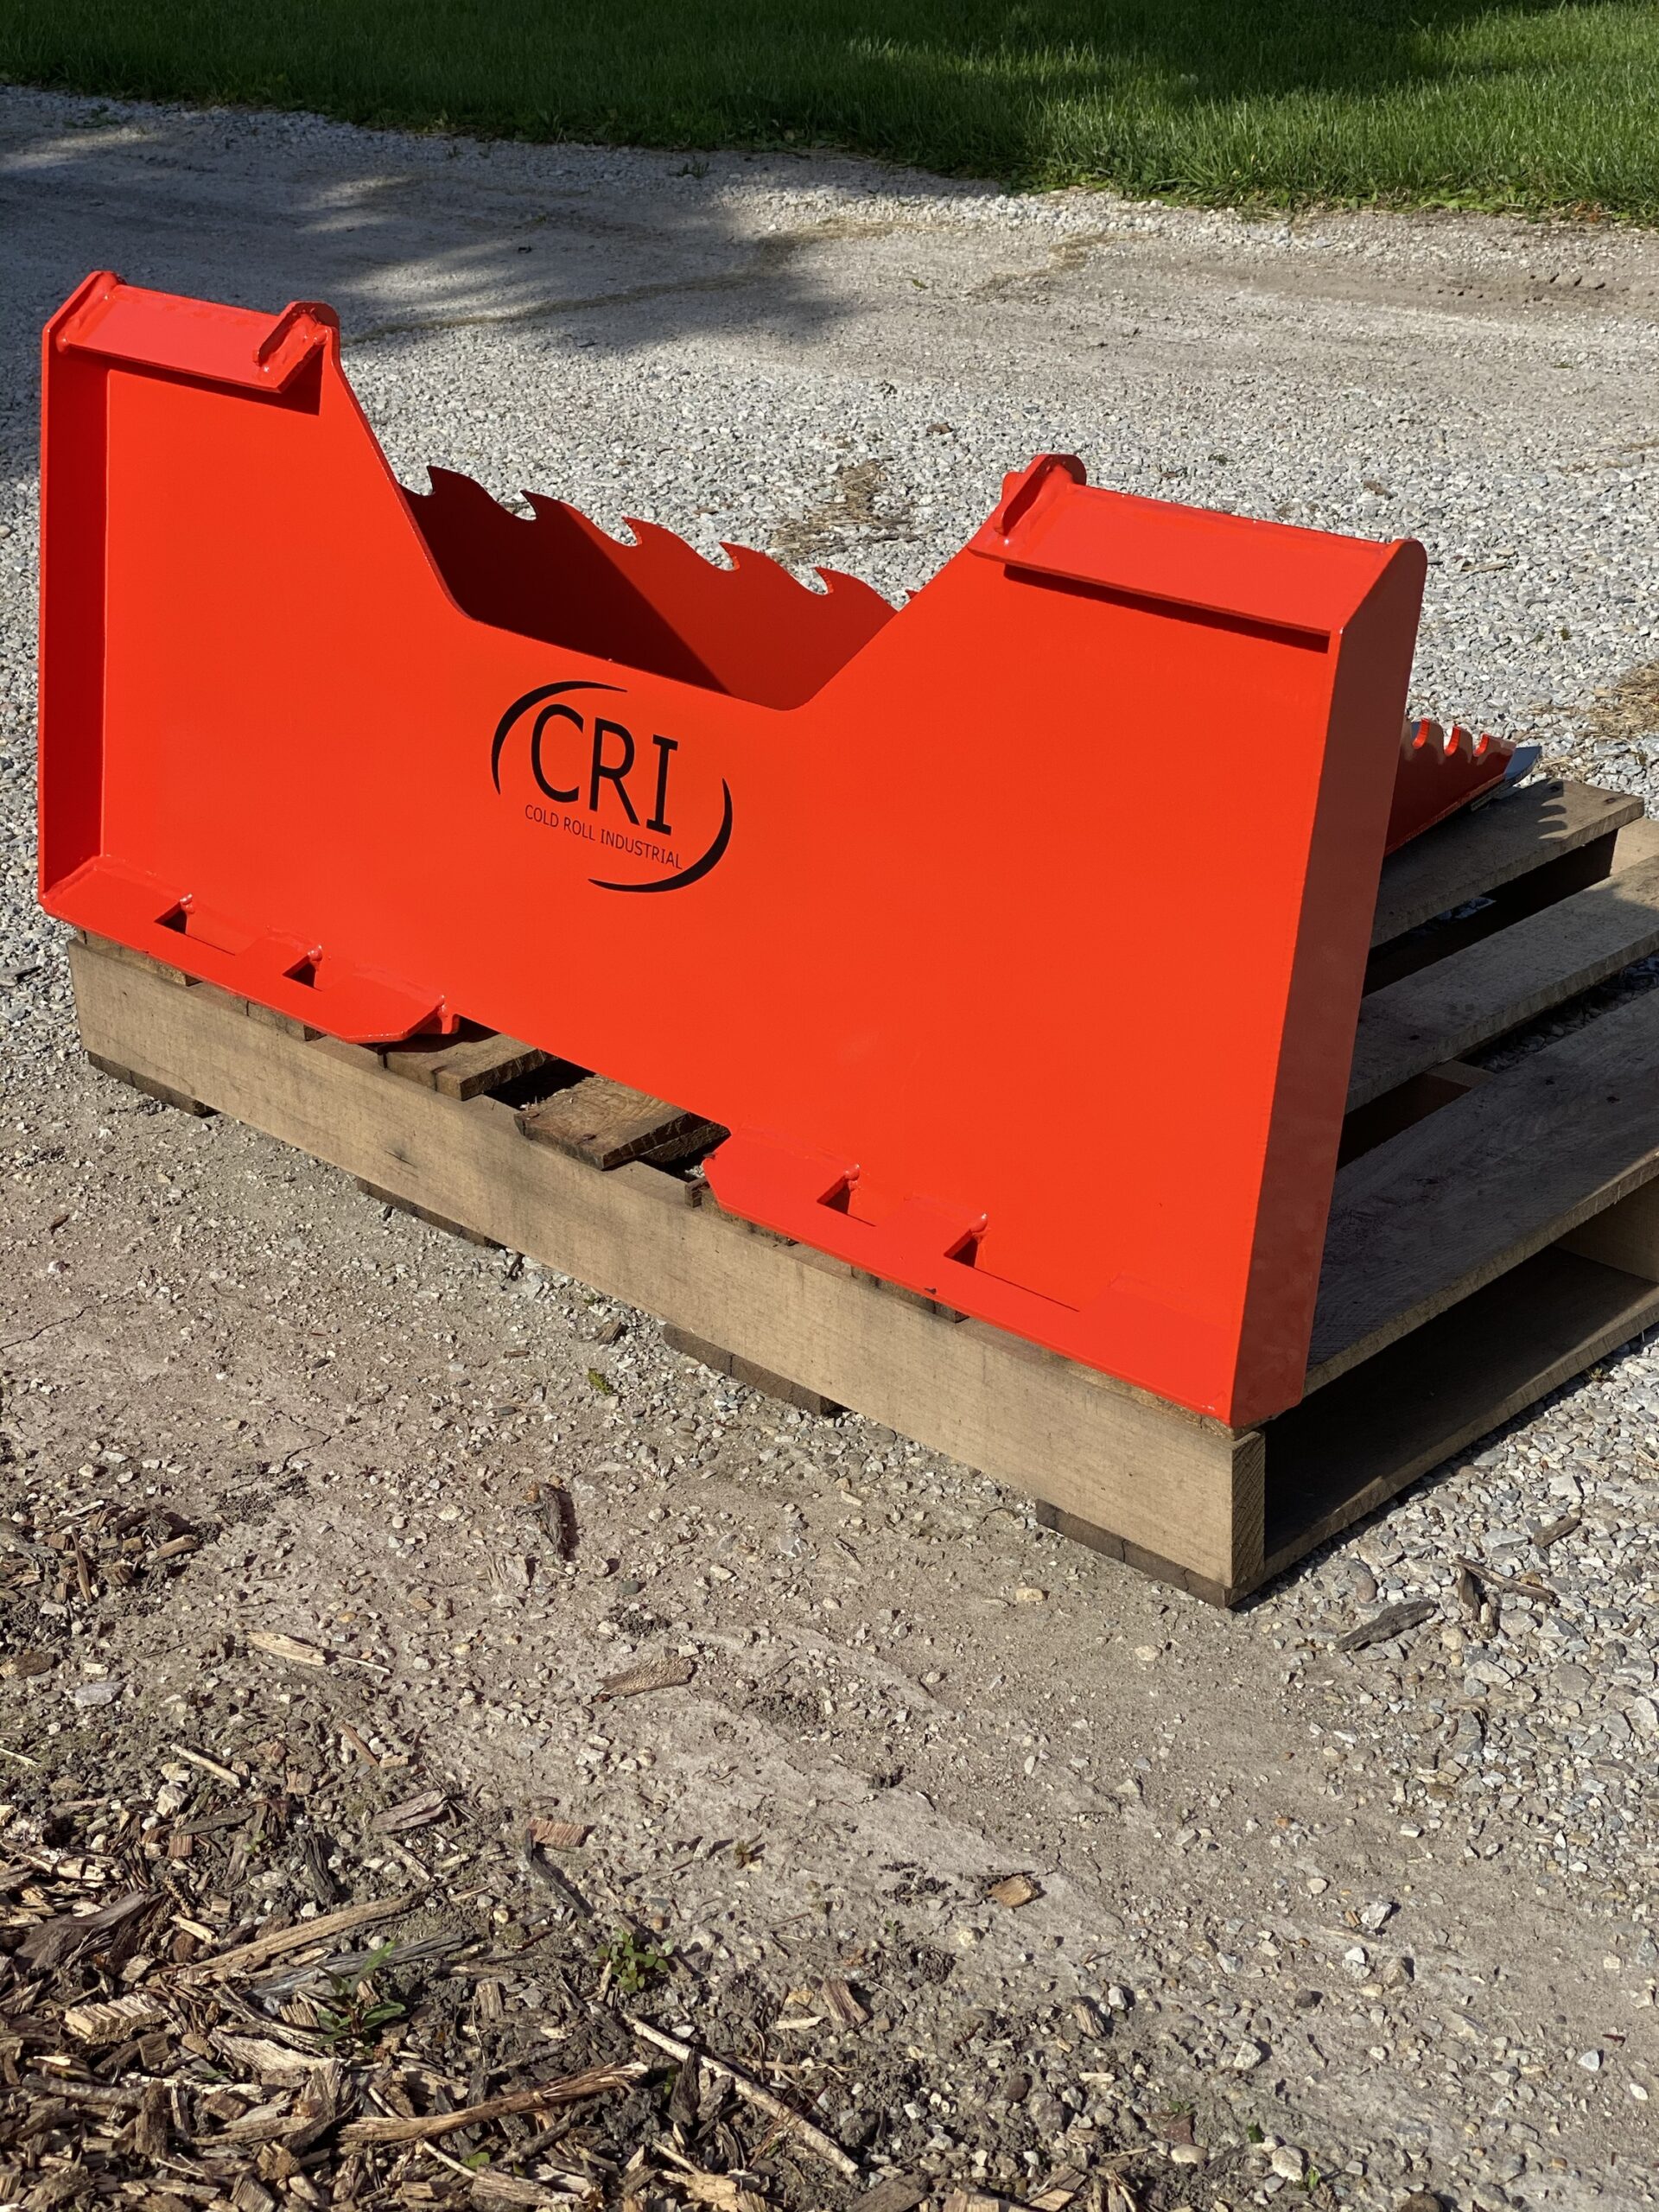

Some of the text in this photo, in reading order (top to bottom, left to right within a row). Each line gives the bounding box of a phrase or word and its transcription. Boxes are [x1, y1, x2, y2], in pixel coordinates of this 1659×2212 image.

[531, 703, 678, 836] CRI
[524, 804, 683, 869] COLD ROLL INDUSTRIAL
